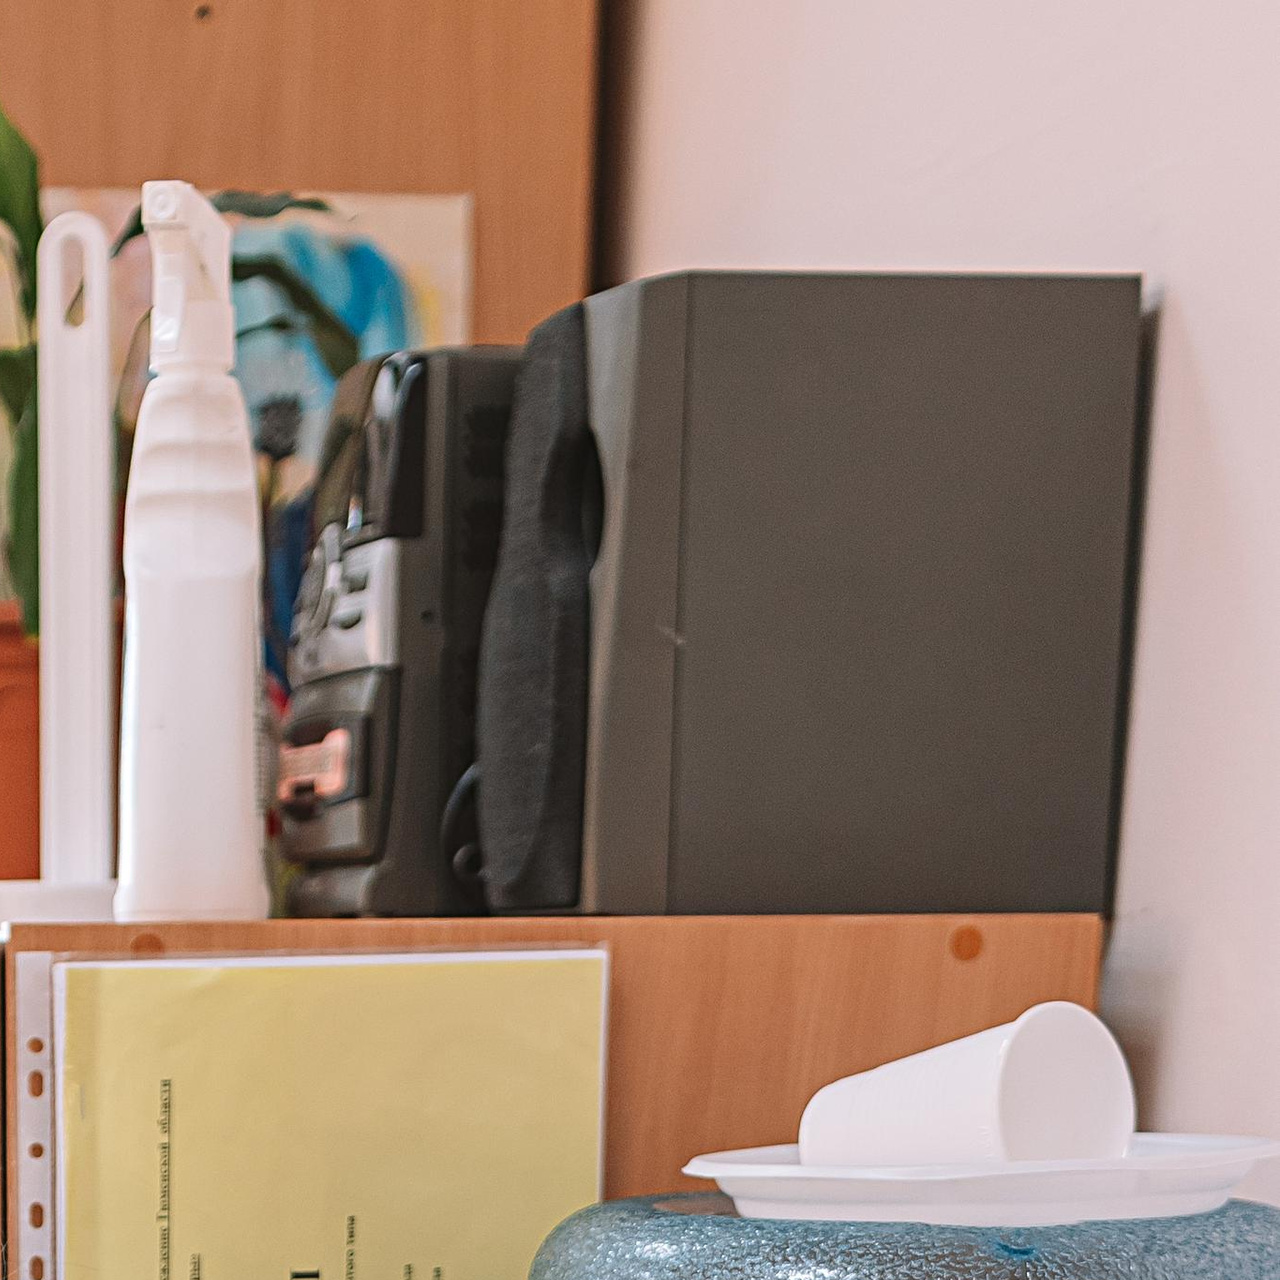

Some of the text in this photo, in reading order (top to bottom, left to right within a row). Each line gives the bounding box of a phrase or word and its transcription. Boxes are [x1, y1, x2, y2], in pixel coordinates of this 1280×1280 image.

[156, 1079, 169, 1134] области
[156, 1142, 168, 1222] Тюменской
[346, 1215, 356, 1245] типа
